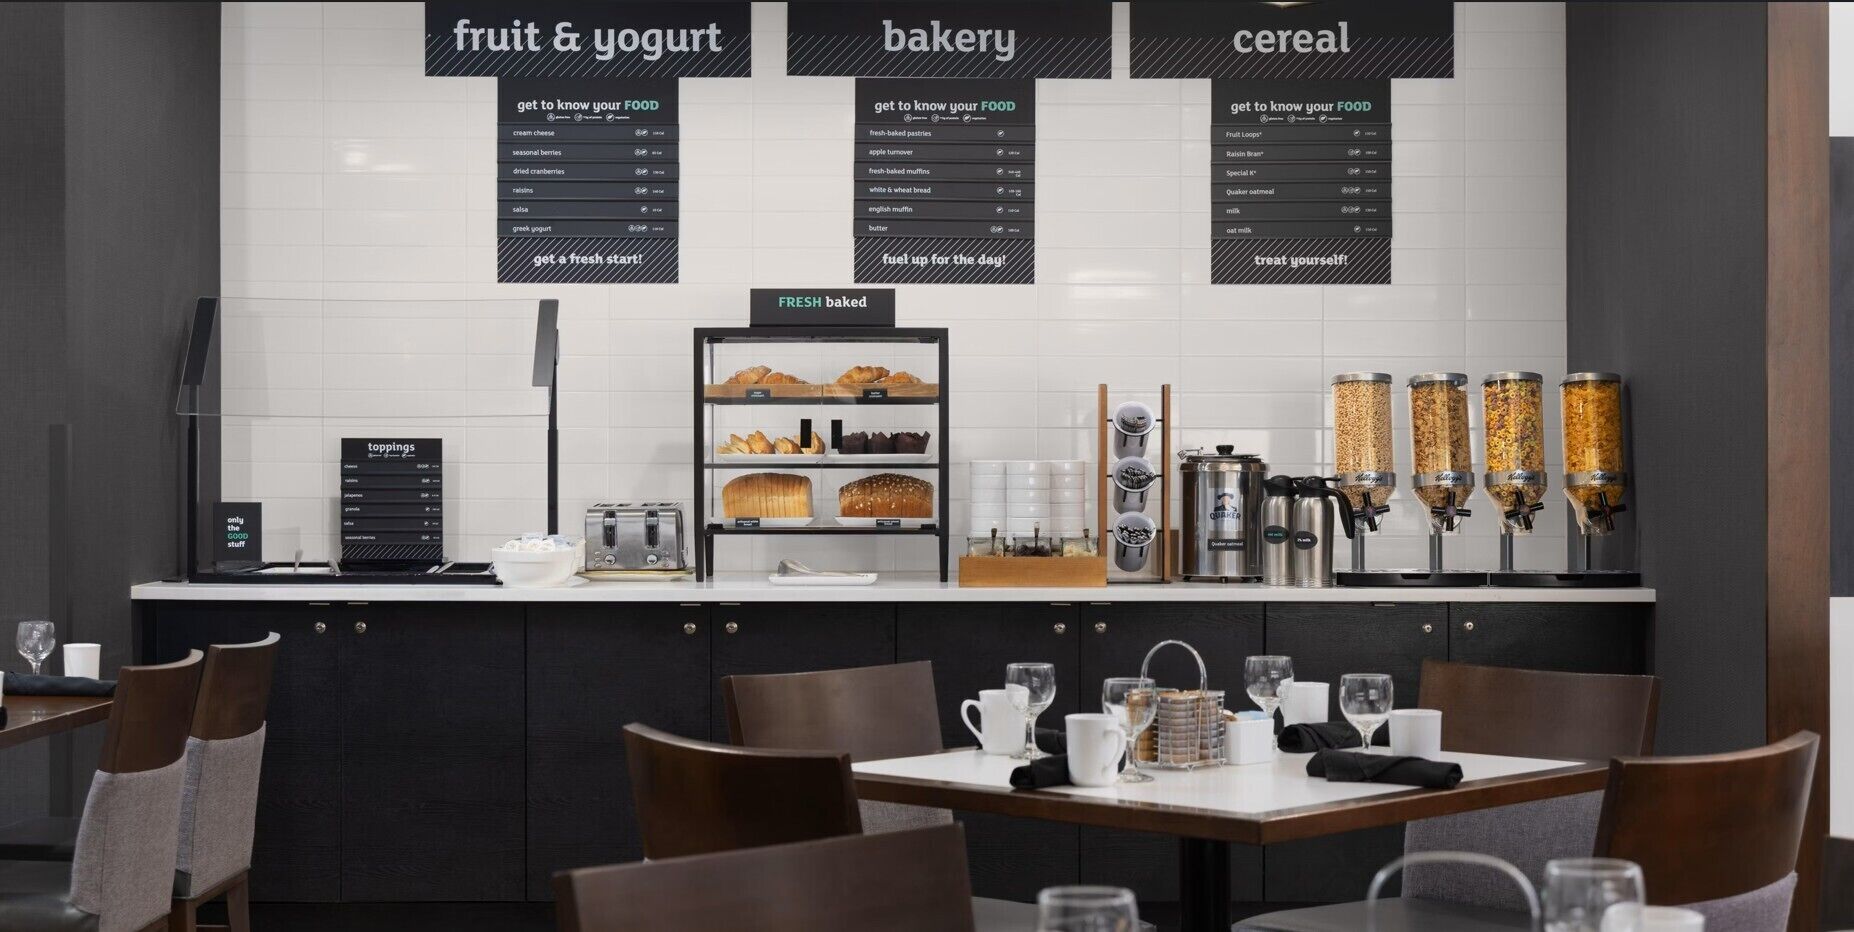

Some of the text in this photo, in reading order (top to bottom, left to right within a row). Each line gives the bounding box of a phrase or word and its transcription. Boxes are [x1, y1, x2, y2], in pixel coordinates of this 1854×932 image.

[453, 19, 722, 61] fruit & yogurt
[882, 20, 1016, 62] bakery
[1233, 22, 1350, 54] cereal
[518, 99, 658, 113] get to know your FOOD
[875, 100, 1015, 114] get to know your FOOD
[1231, 101, 1371, 114] get to know your FOOD
[533, 253, 643, 266] get a fresh start!
[882, 253, 1006, 267] fuel up for the day!
[1254, 254, 1348, 268] treat yourself!
[779, 296, 867, 307] FRESH baked
[368, 442, 415, 453] toppings
[1210, 512, 1241, 520] QUAKER
